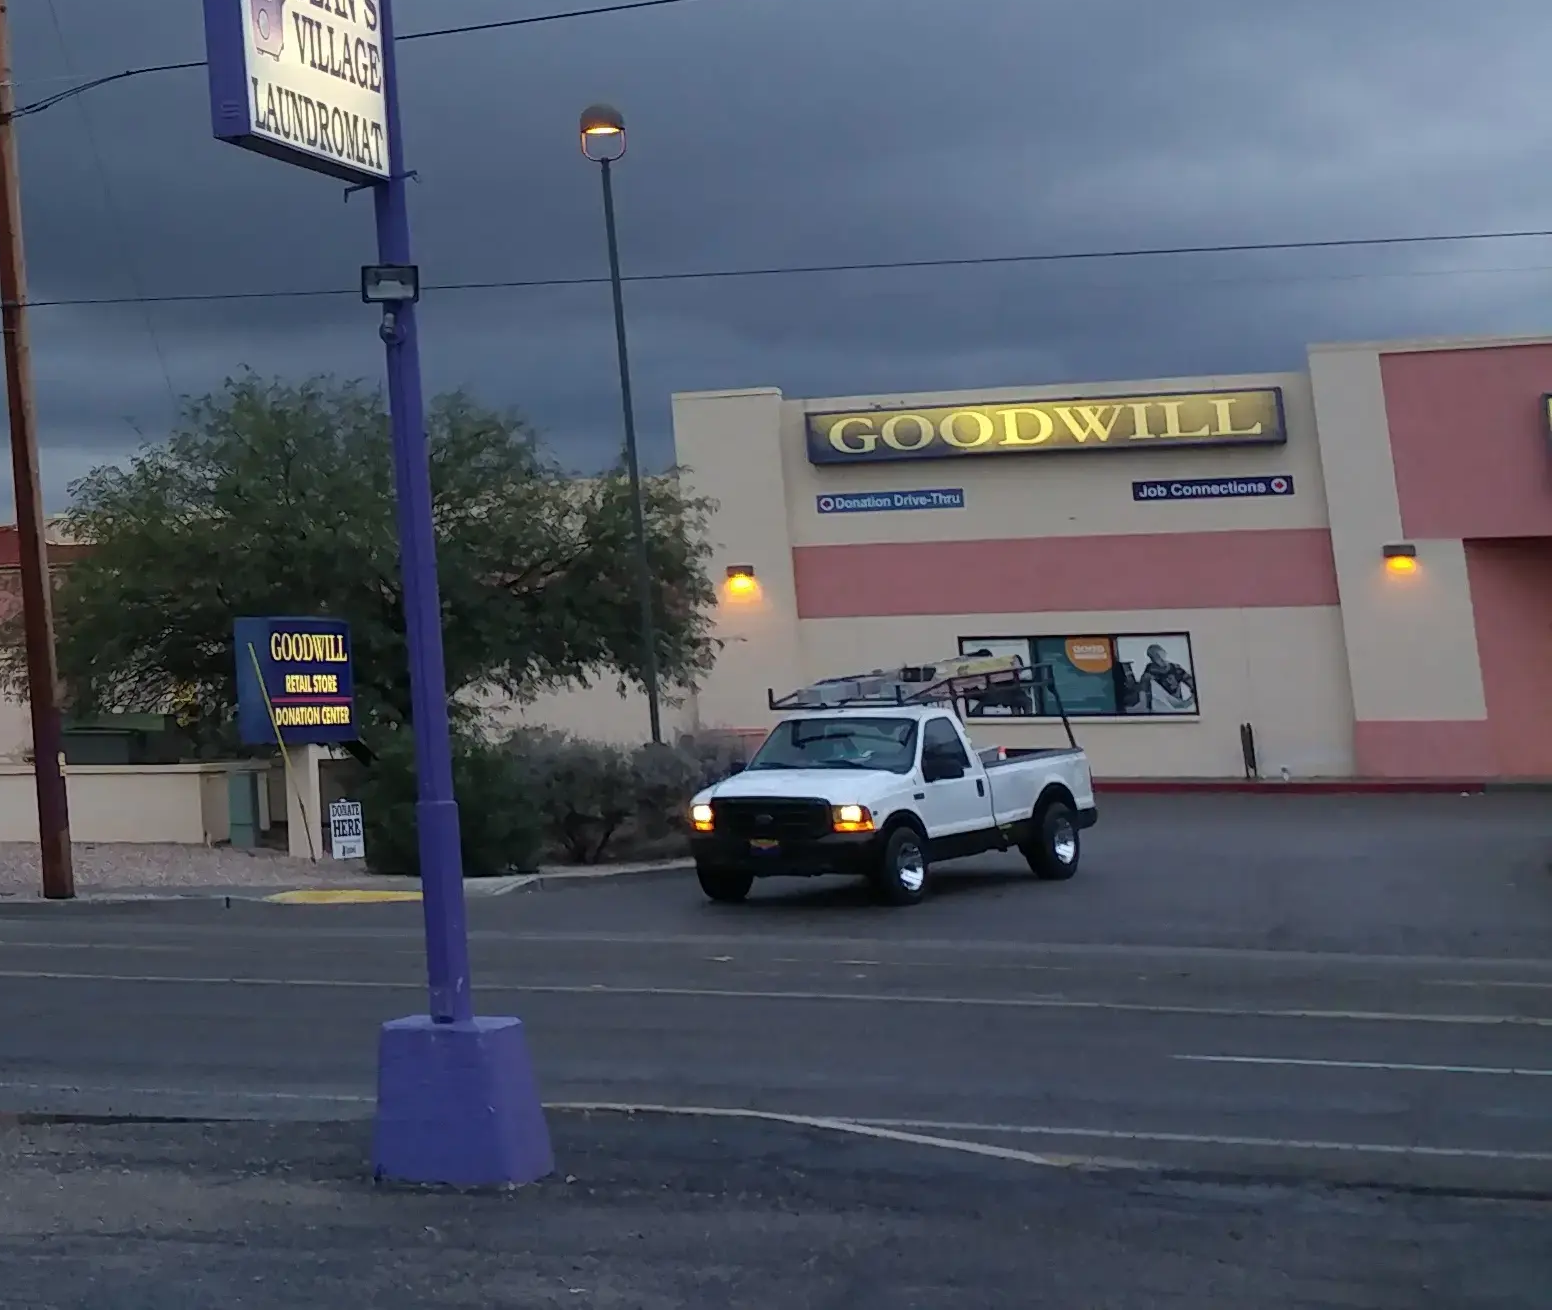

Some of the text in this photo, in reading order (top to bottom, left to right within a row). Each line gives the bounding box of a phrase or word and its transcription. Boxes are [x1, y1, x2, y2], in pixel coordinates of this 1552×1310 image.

[291, 11, 382, 94] VILLAGE
[251, 76, 384, 171] LAUNDROMAT
[828, 398, 1263, 455] GOODWILL
[1138, 480, 1267, 498] Job Connections
[835, 492, 961, 510] Donation Drive-Thru
[270, 632, 348, 662] GOODWILL
[285, 674, 338, 693] RETAIL STORE
[275, 705, 351, 726] DONATION CENTER
[331, 803, 360, 817] DONATE
[333, 818, 362, 837] HERE
